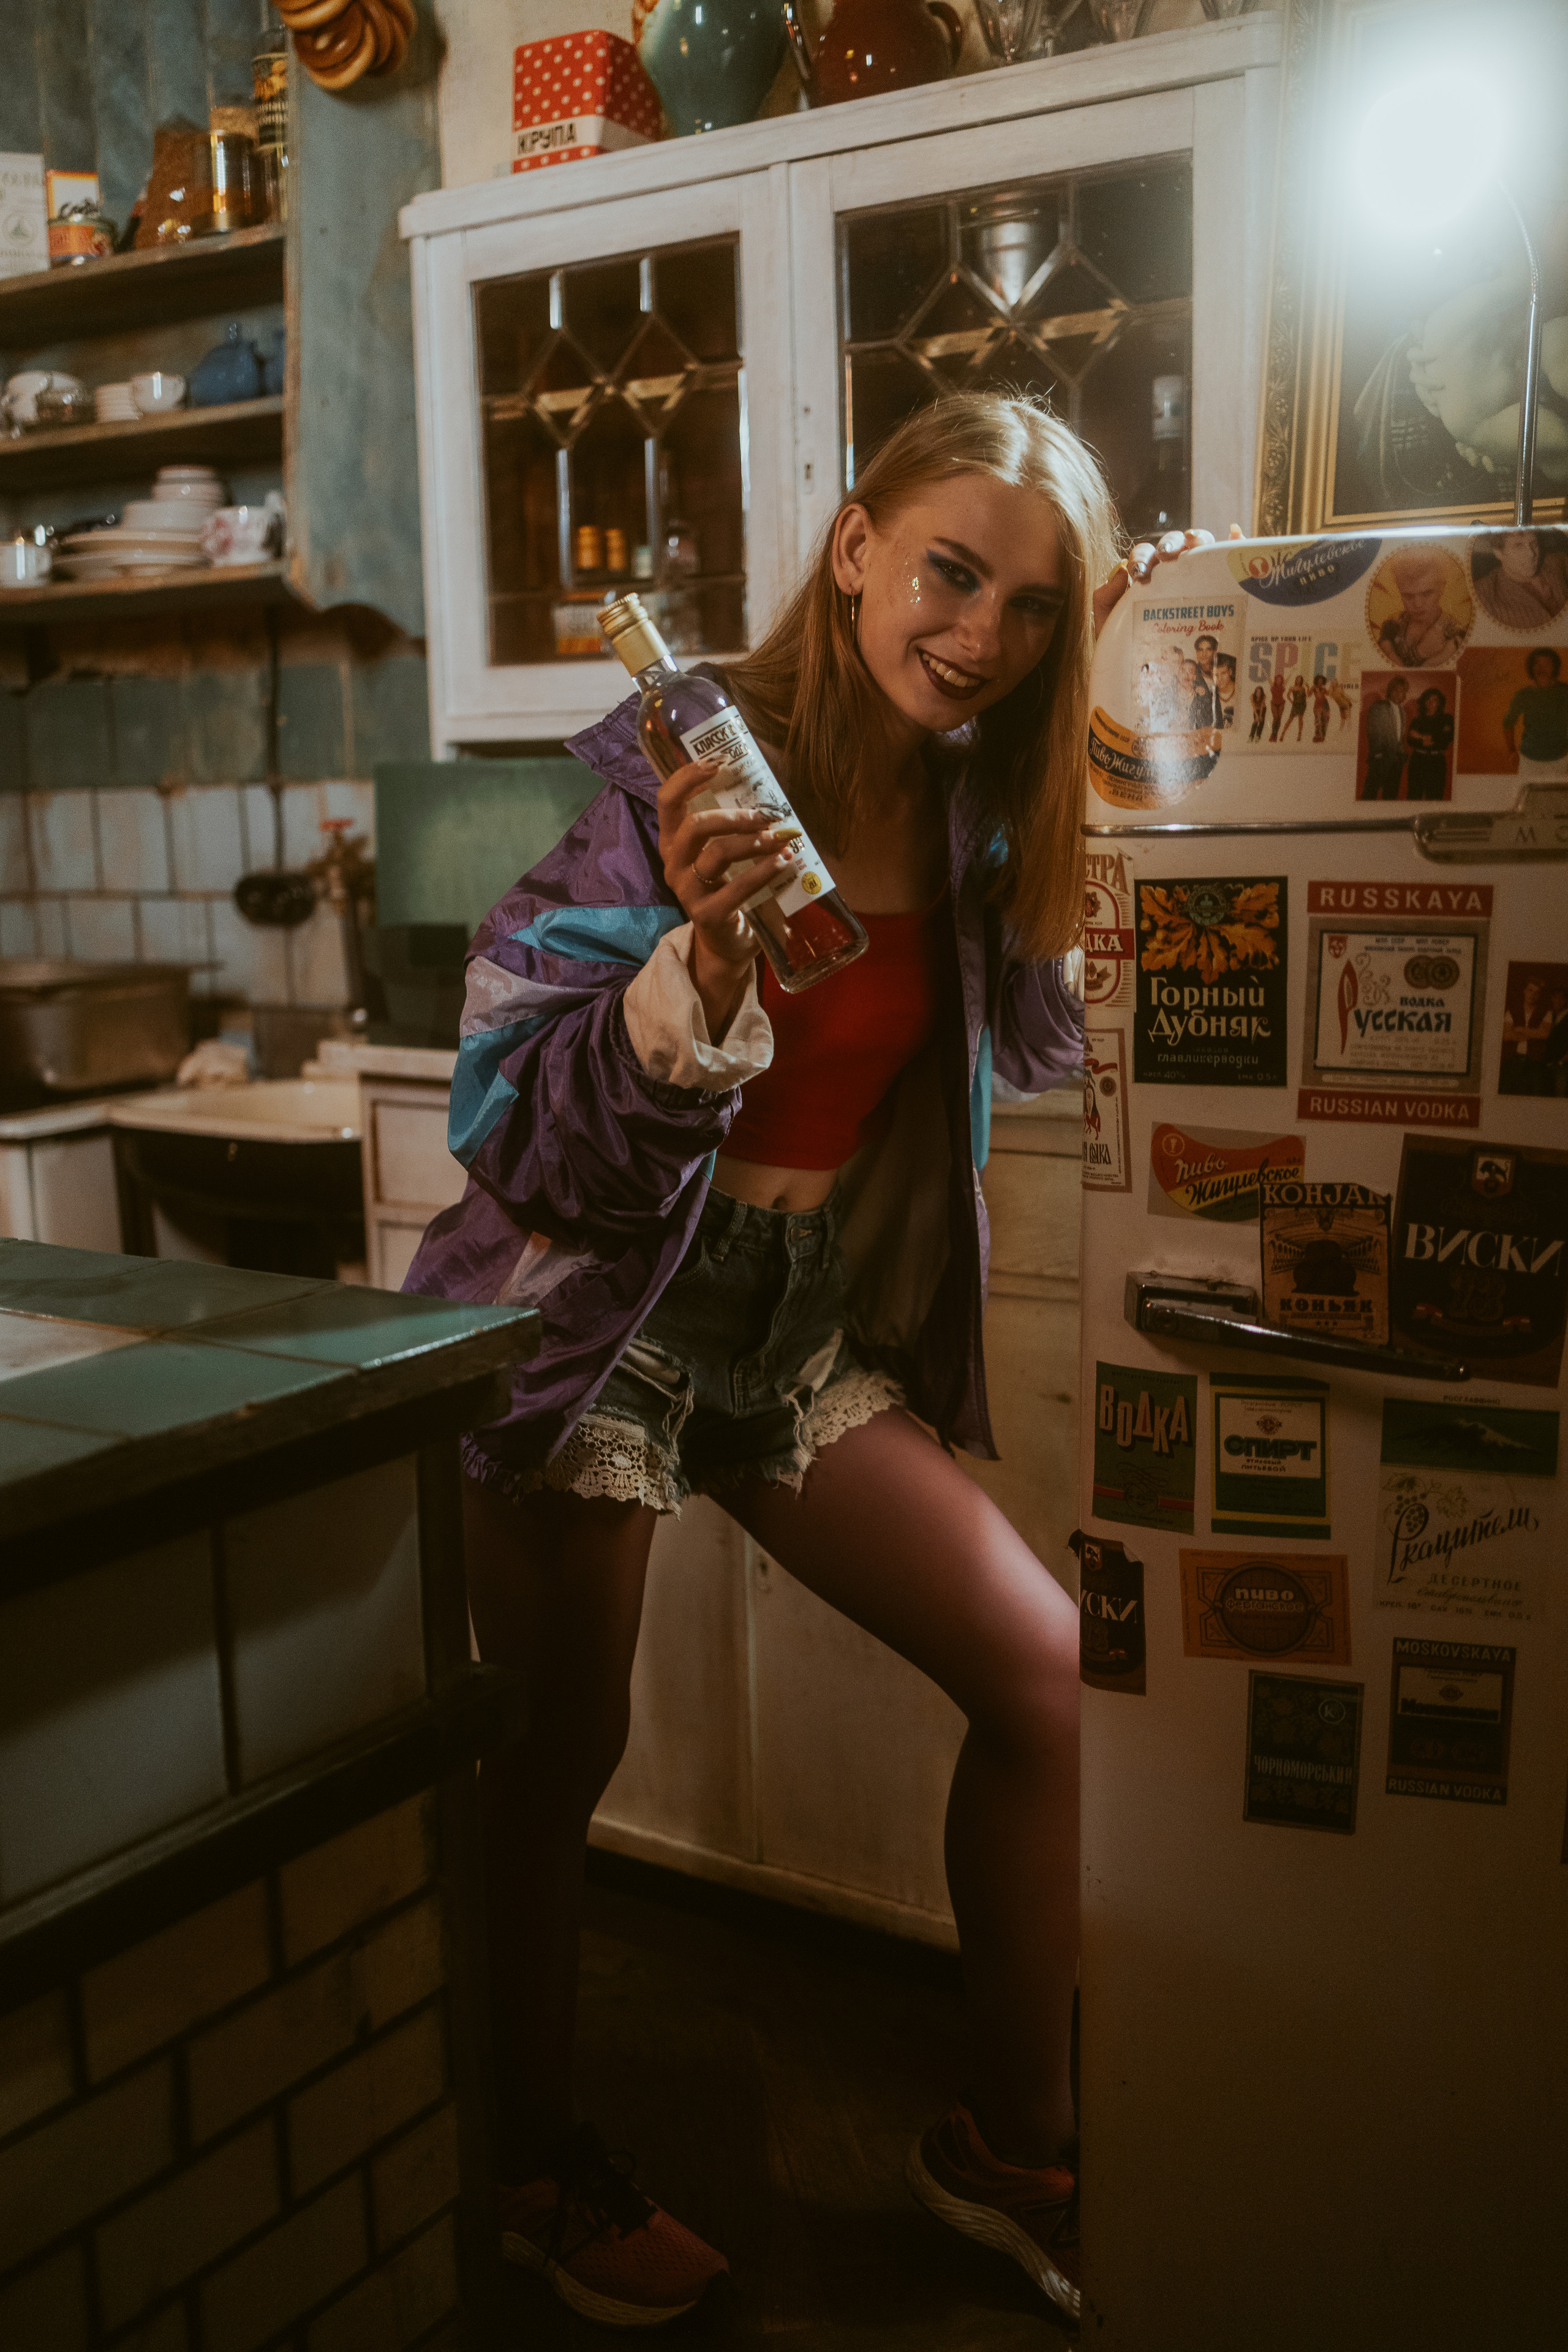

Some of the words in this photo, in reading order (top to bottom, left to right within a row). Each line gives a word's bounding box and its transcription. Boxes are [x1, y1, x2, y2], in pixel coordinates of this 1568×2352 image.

[518, 123, 577, 155] КРУПА
[1144, 606, 1205, 621] BACKSTREET
[1207, 605, 1234, 617] BOYS
[1152, 622, 1196, 636] Coloring
[1198, 619, 1224, 631] Book
[1248, 642, 1362, 683] SPICE
[1320, 887, 1482, 911] RUSSKAYA
[1150, 975, 1265, 1011] Горный
[1148, 1007, 1271, 1047] Дубняк
[1158, 1054, 1259, 1068] главликерводки
[1310, 1096, 1398, 1117] RUSSIAN
[1405, 1102, 1469, 1120] VODKA
[1404, 1223, 1566, 1277] ВИСКИ
[1280, 1298, 1373, 1313] КОНЬЯК
[1099, 1384, 1188, 1453] ВОДКА
[1224, 1434, 1317, 1461] СПИРТ
[1427, 1573, 1521, 1591] ДЕСЕРТНОЕ
[1396, 1640, 1510, 1662] MOSKOVSKAYA
[1389, 1778, 1450, 1796] RUSSIAN
[1453, 1784, 1502, 1801] VODKA
